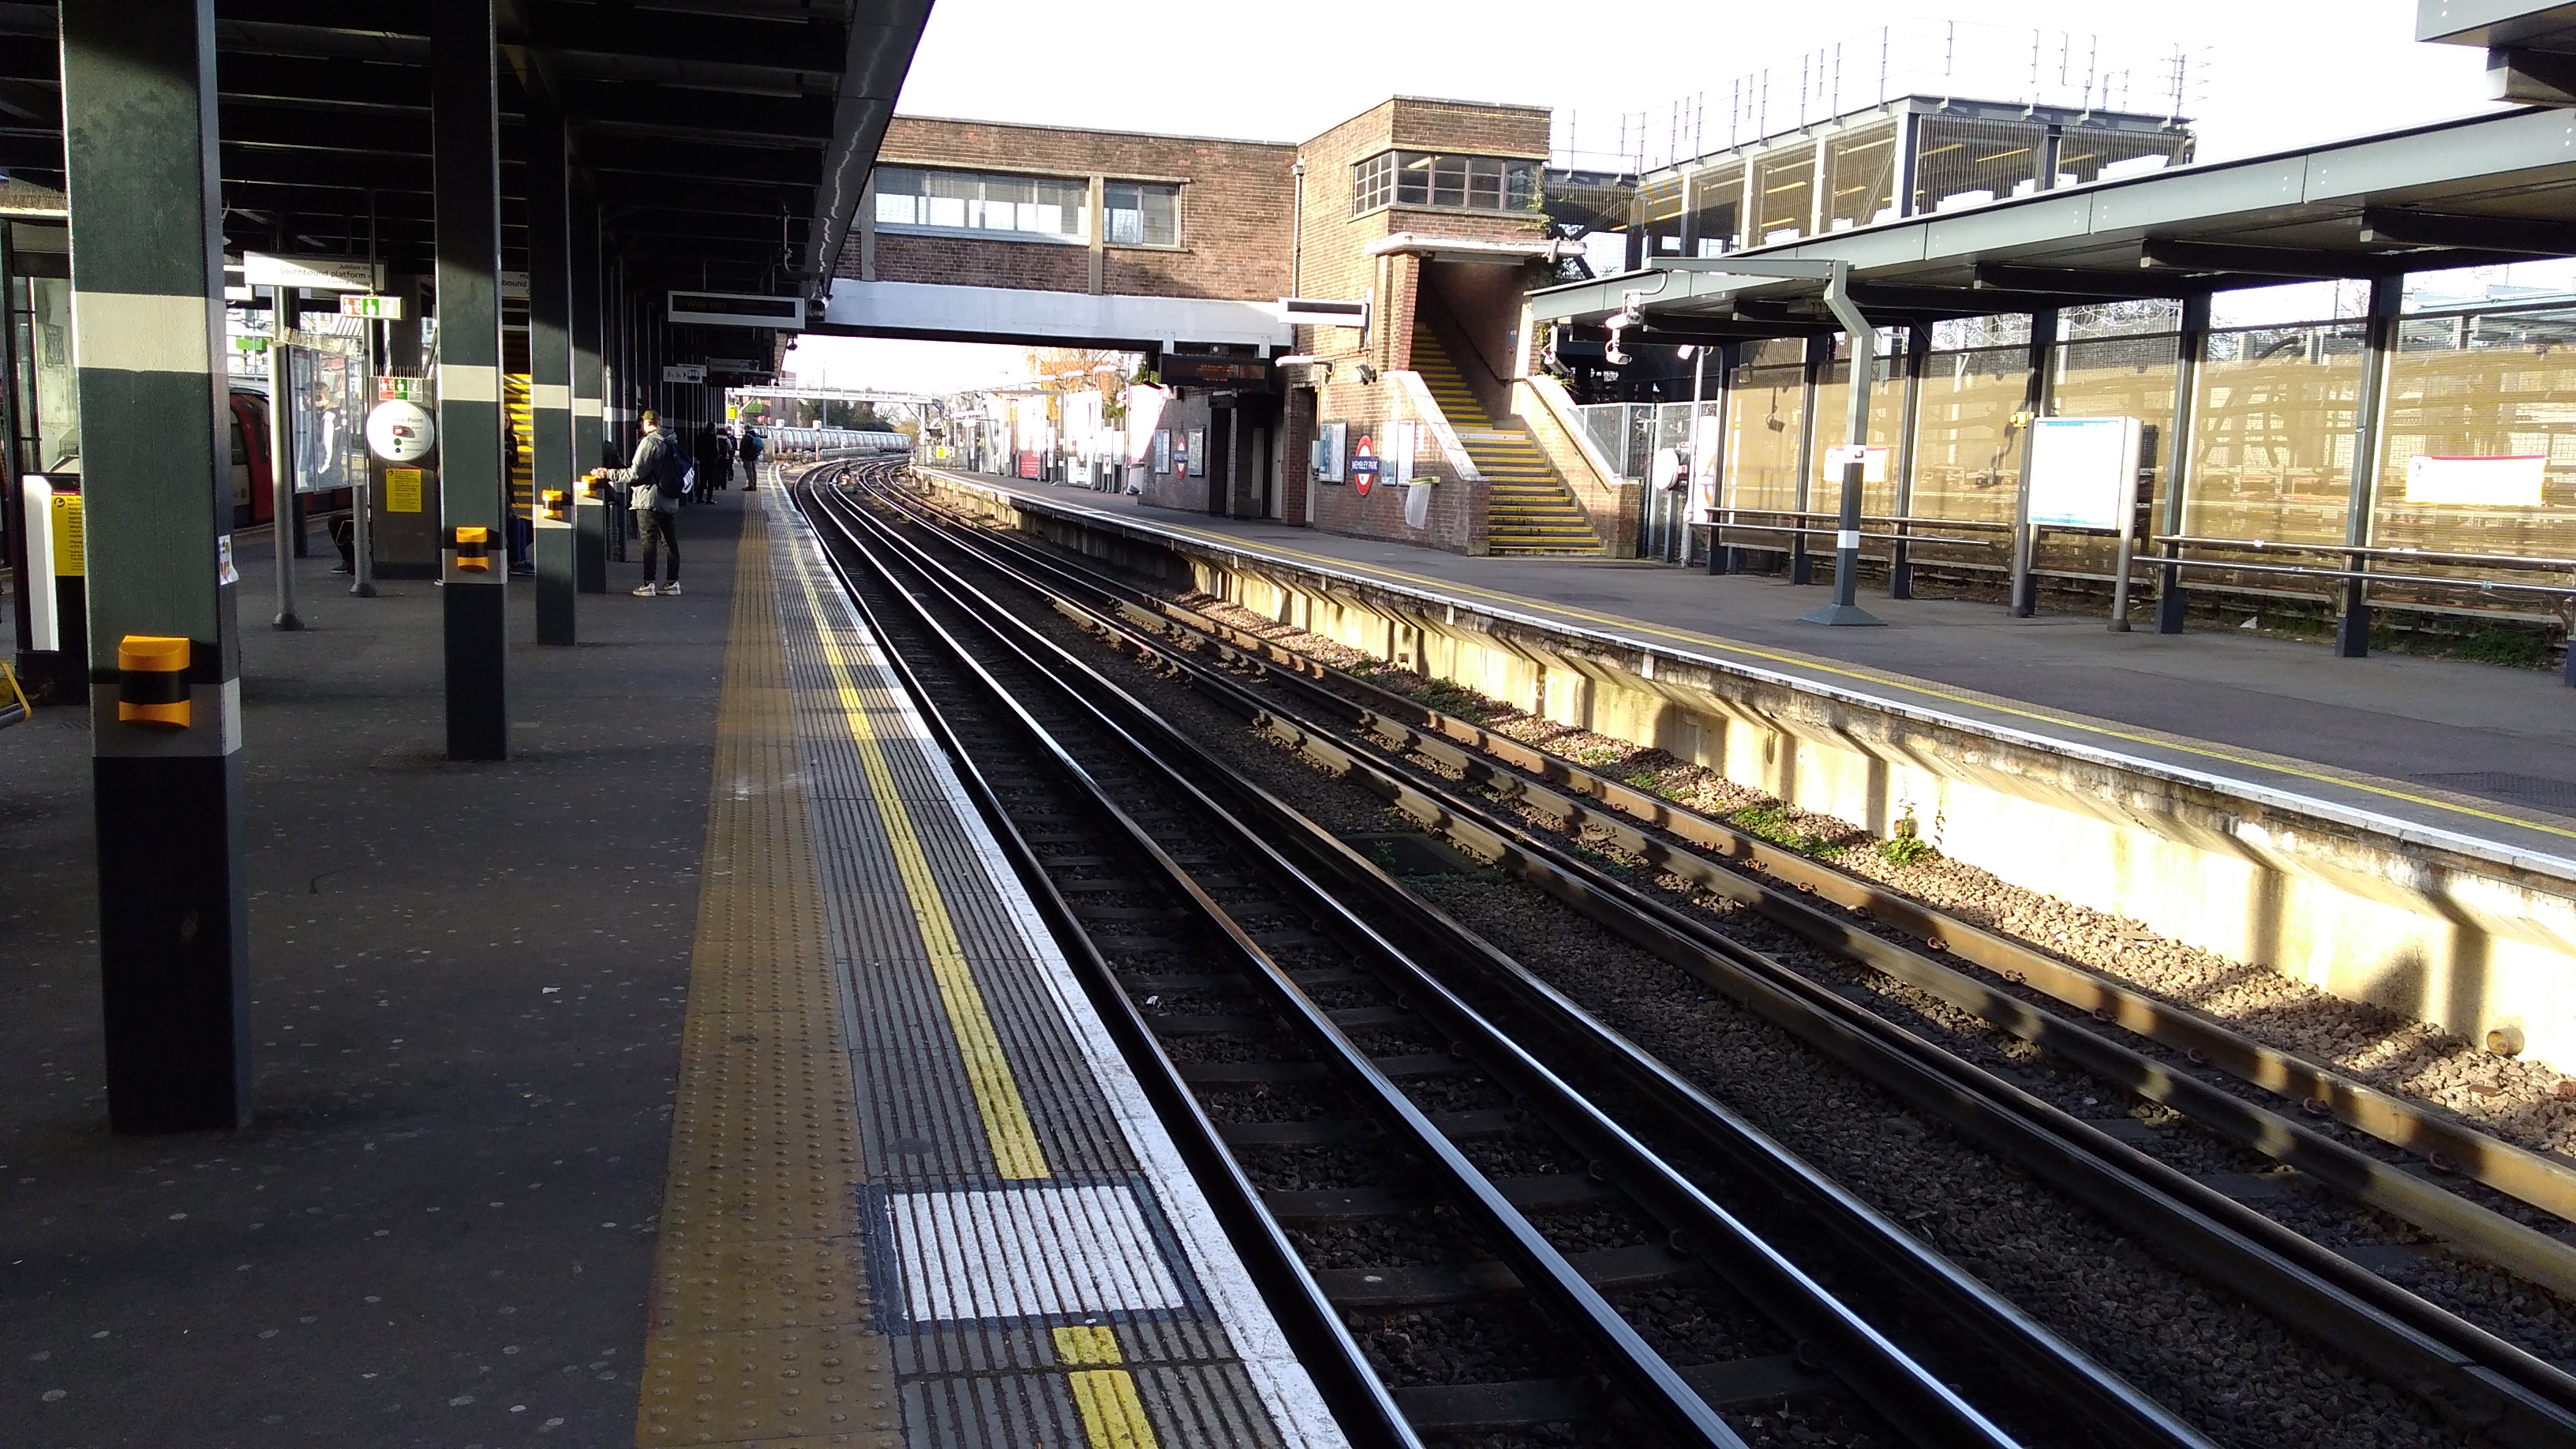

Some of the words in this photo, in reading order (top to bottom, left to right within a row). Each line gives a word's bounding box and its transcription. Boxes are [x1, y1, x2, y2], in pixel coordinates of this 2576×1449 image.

[279, 268, 329, 277] Southbound
[331, 270, 366, 279] platform
[1351, 460, 1368, 470] WEMBLEY
[1368, 460, 1378, 470] PARK
